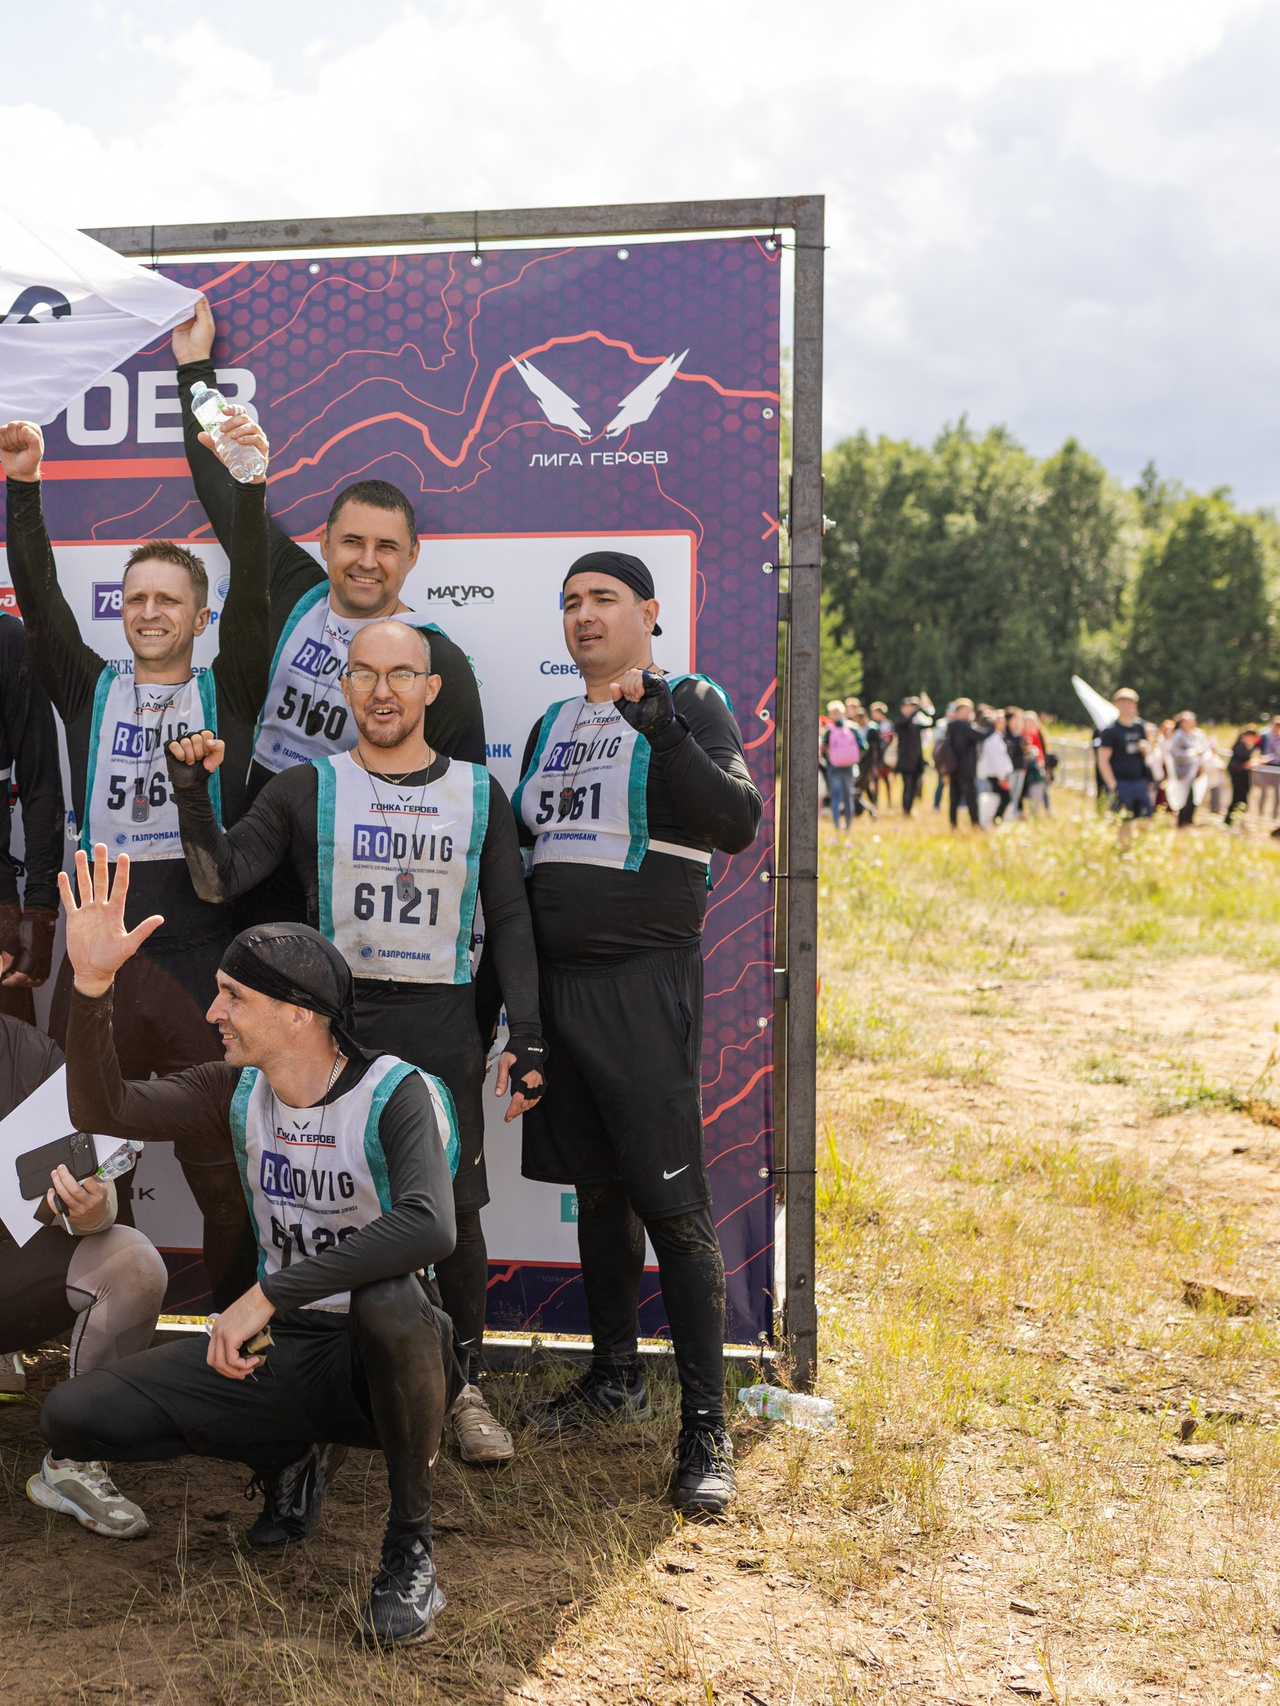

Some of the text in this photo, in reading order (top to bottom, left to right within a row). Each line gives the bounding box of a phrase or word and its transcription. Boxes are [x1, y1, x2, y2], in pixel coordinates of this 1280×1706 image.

[528, 450, 669, 468] ЛИГА ГЕРОЕВ
[427, 585, 494, 602] МАГУРО
[295, 643, 349, 682] RODV
[546, 736, 622, 767] RODVIG
[107, 771, 178, 811] 516
[535, 782, 602, 825] 561
[371, 802, 439, 814] ГОНКА ГЕРОЕВ
[356, 829, 453, 863] RODVIG
[552, 832, 597, 842] ГАЗПРОМБАНК
[353, 882, 440, 926] 6121
[377, 949, 431, 961] ГАЗПРОМБАНК
[300, 1133, 336, 1144] ГЕРОЕВ
[263, 1157, 355, 1202] RODVIG
